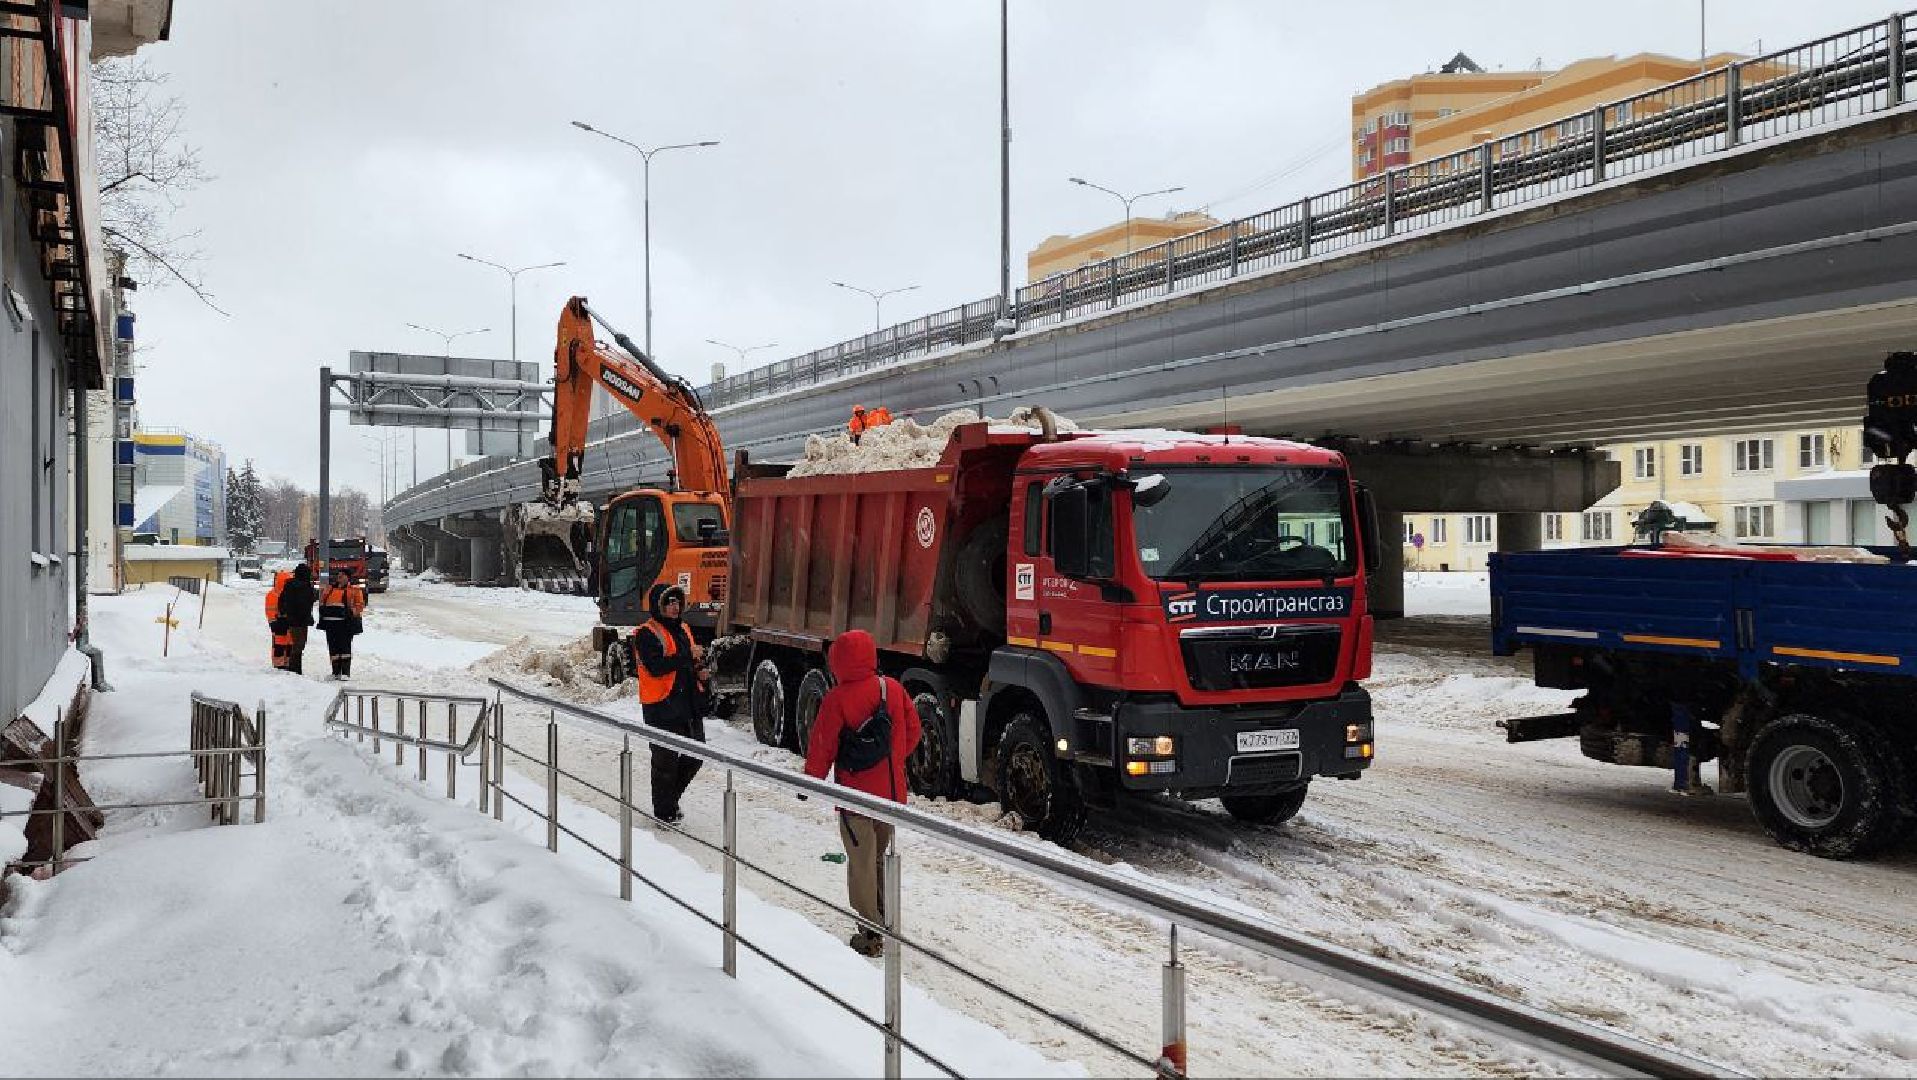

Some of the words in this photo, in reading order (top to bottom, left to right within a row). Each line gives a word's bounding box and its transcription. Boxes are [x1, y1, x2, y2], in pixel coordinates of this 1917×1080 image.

[602, 370, 640, 399] DOOSAN
[1206, 592, 1344, 619] Стройтрансгаз
[1230, 651, 1300, 672] MAN
